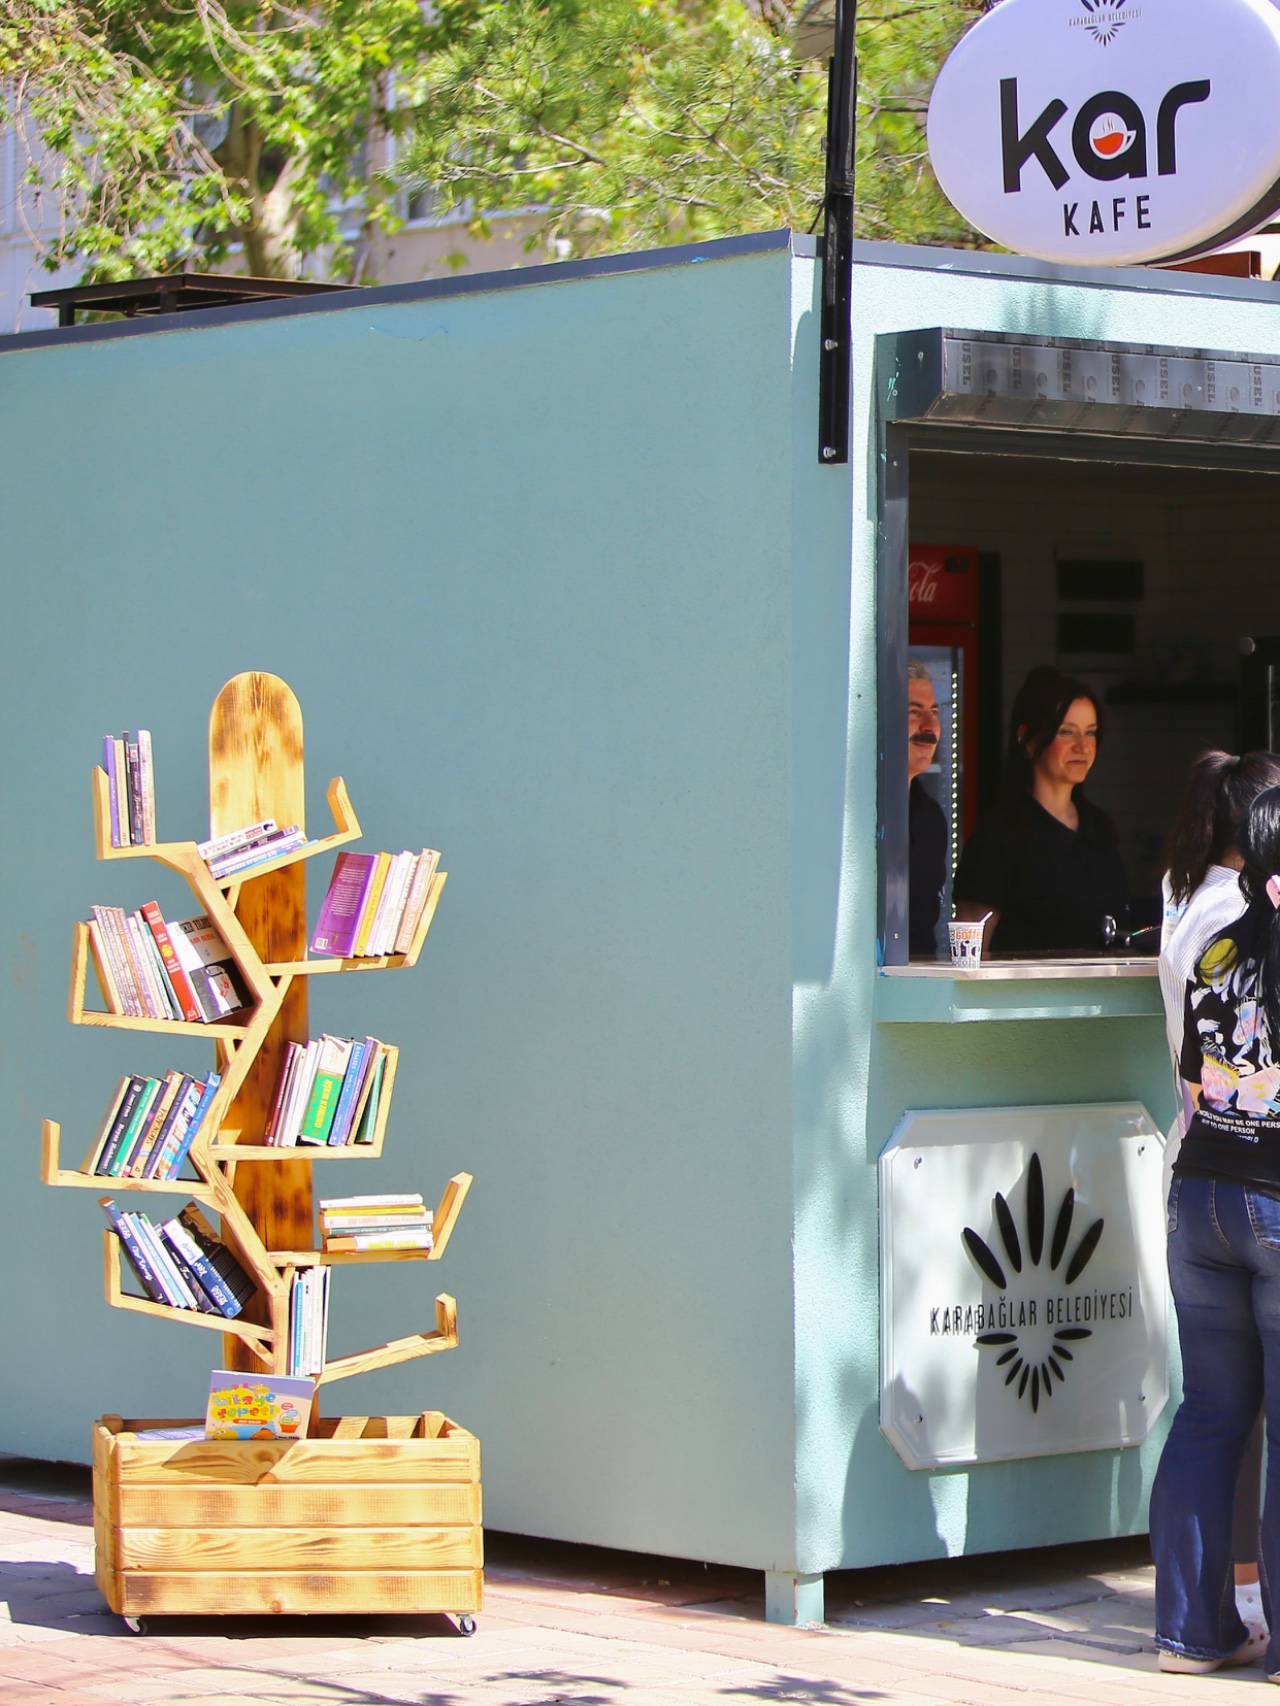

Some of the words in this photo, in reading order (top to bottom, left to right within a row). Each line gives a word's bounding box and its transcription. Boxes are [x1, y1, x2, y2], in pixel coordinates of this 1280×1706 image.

[999, 77, 1211, 194] kar
[1063, 194, 1151, 237] KAFE
[908, 561, 941, 602] ola
[1218, 1123, 1229, 1132] ONE
[1230, 1124, 1255, 1134] PERSON
[931, 1296, 1037, 1334] KARABAĞLAR
[1047, 1286, 1133, 1325] BELEDİYESİ
